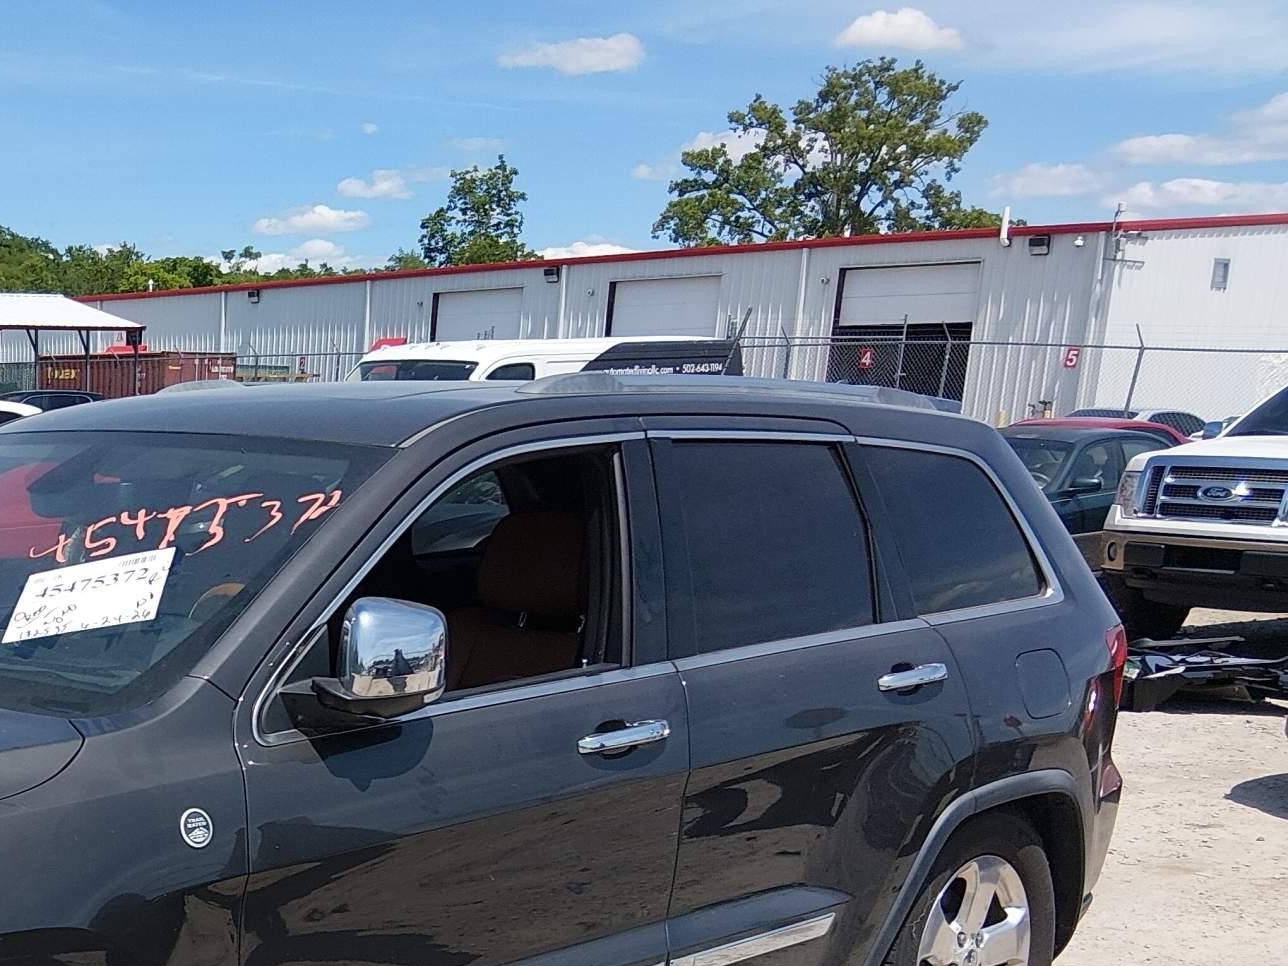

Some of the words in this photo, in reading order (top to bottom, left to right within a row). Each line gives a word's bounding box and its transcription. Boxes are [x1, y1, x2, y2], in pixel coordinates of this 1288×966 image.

[861, 350, 873, 366] 4
[1066, 350, 1078, 366] 5
[682, 362, 723, 374] 502-643-1194
